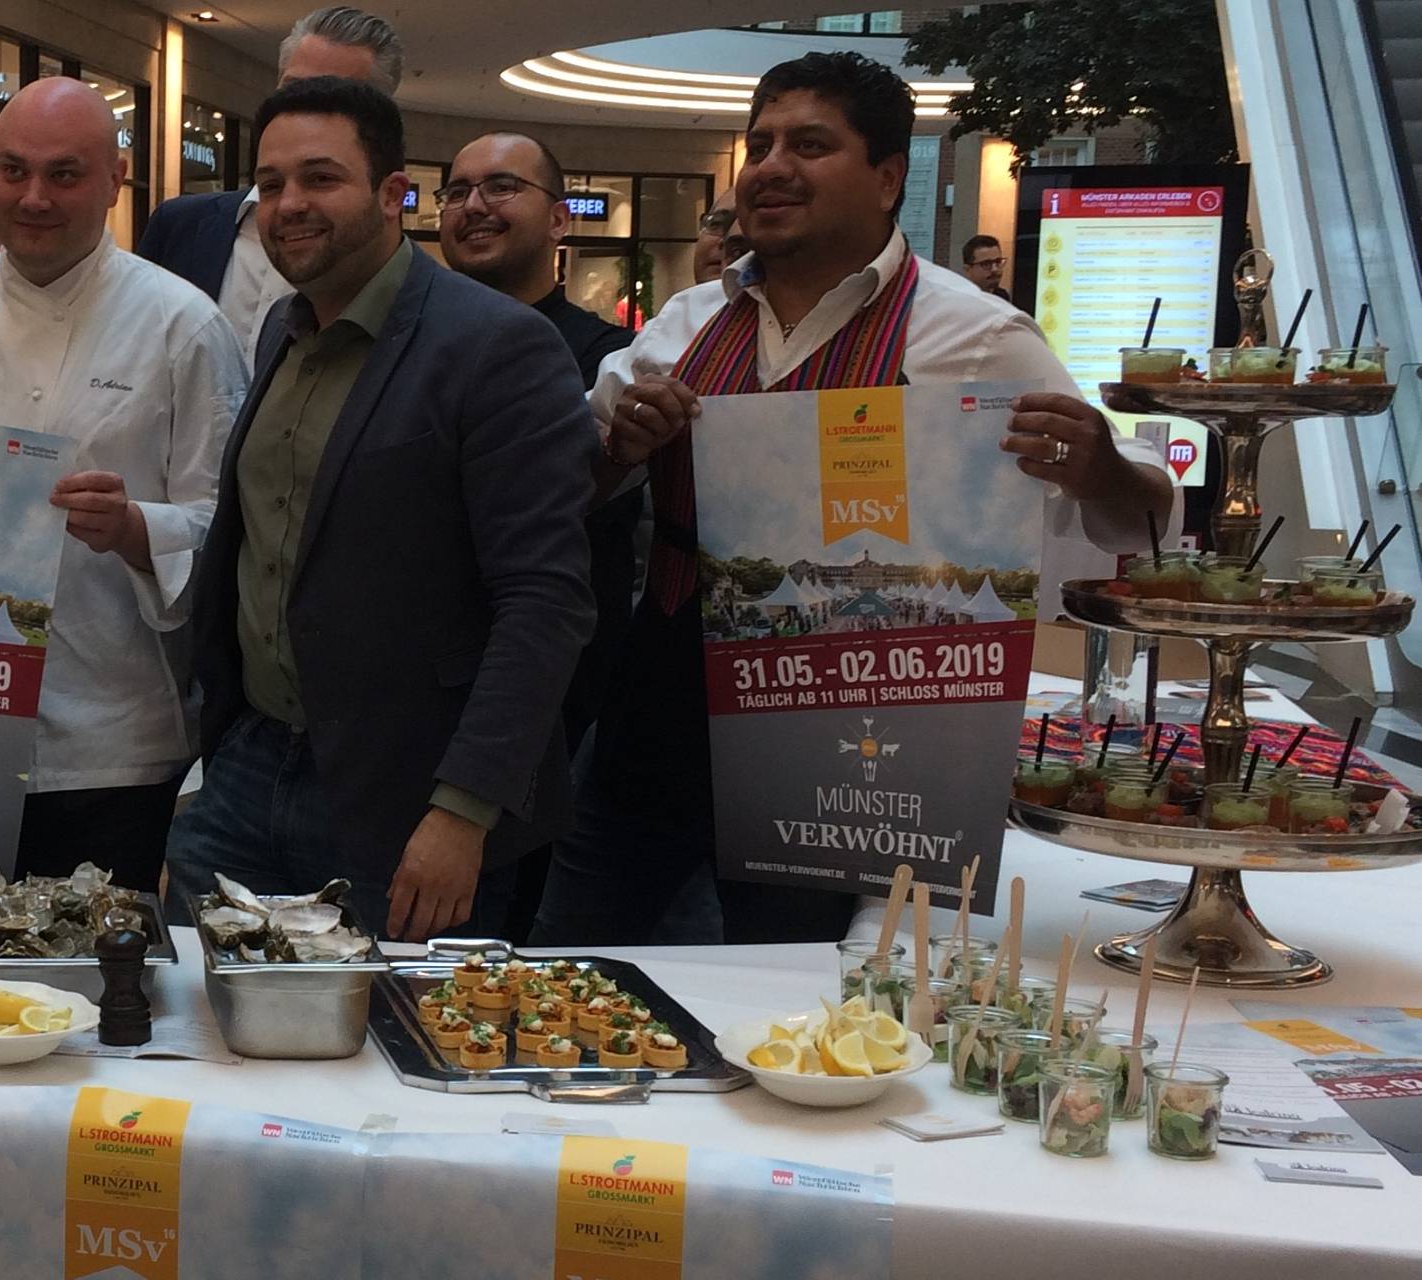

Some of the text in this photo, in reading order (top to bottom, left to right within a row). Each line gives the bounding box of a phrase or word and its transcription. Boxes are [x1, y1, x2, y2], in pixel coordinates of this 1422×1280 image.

[832, 459, 893, 470] PRINZIPAL
[737, 691, 793, 709] TÄGLICH
[798, 691, 816, 705] AB
[820, 690, 833, 703] 11
[838, 689, 867, 702] UHR
[880, 685, 940, 700] SCHLOSS
[944, 680, 1004, 698] MÜNSTER
[816, 783, 922, 827] MÜNSTER
[94, 1142, 155, 1157] GROSSMARKT
[83, 1174, 162, 1193] PRINZIPAL
[587, 1190, 655, 1205] GROSSMARKT
[575, 1222, 663, 1244] PRINZIPAL
